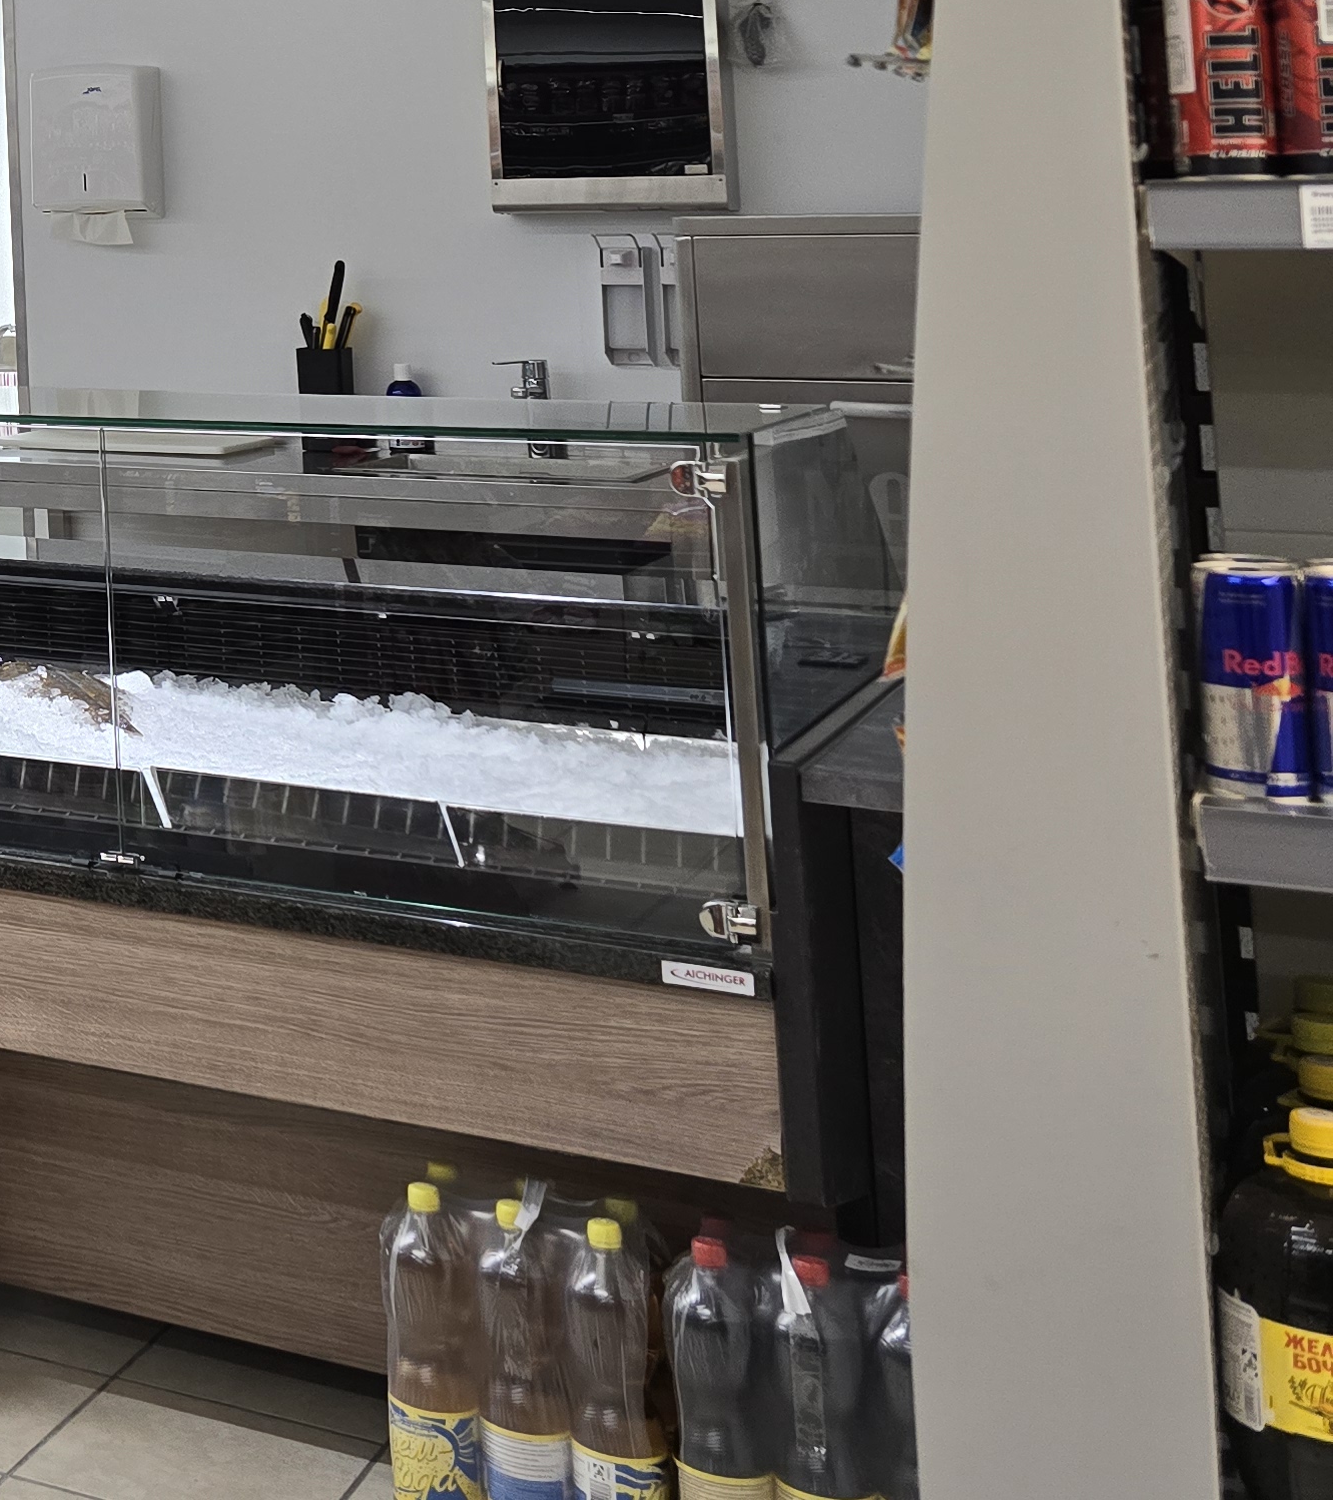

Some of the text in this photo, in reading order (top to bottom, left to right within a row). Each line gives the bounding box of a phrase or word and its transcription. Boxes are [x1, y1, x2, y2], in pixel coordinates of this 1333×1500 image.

[1204, 25, 1266, 137] HELL
[1222, 649, 1282, 676] Red
[684, 969, 746, 987] AICHINGER
